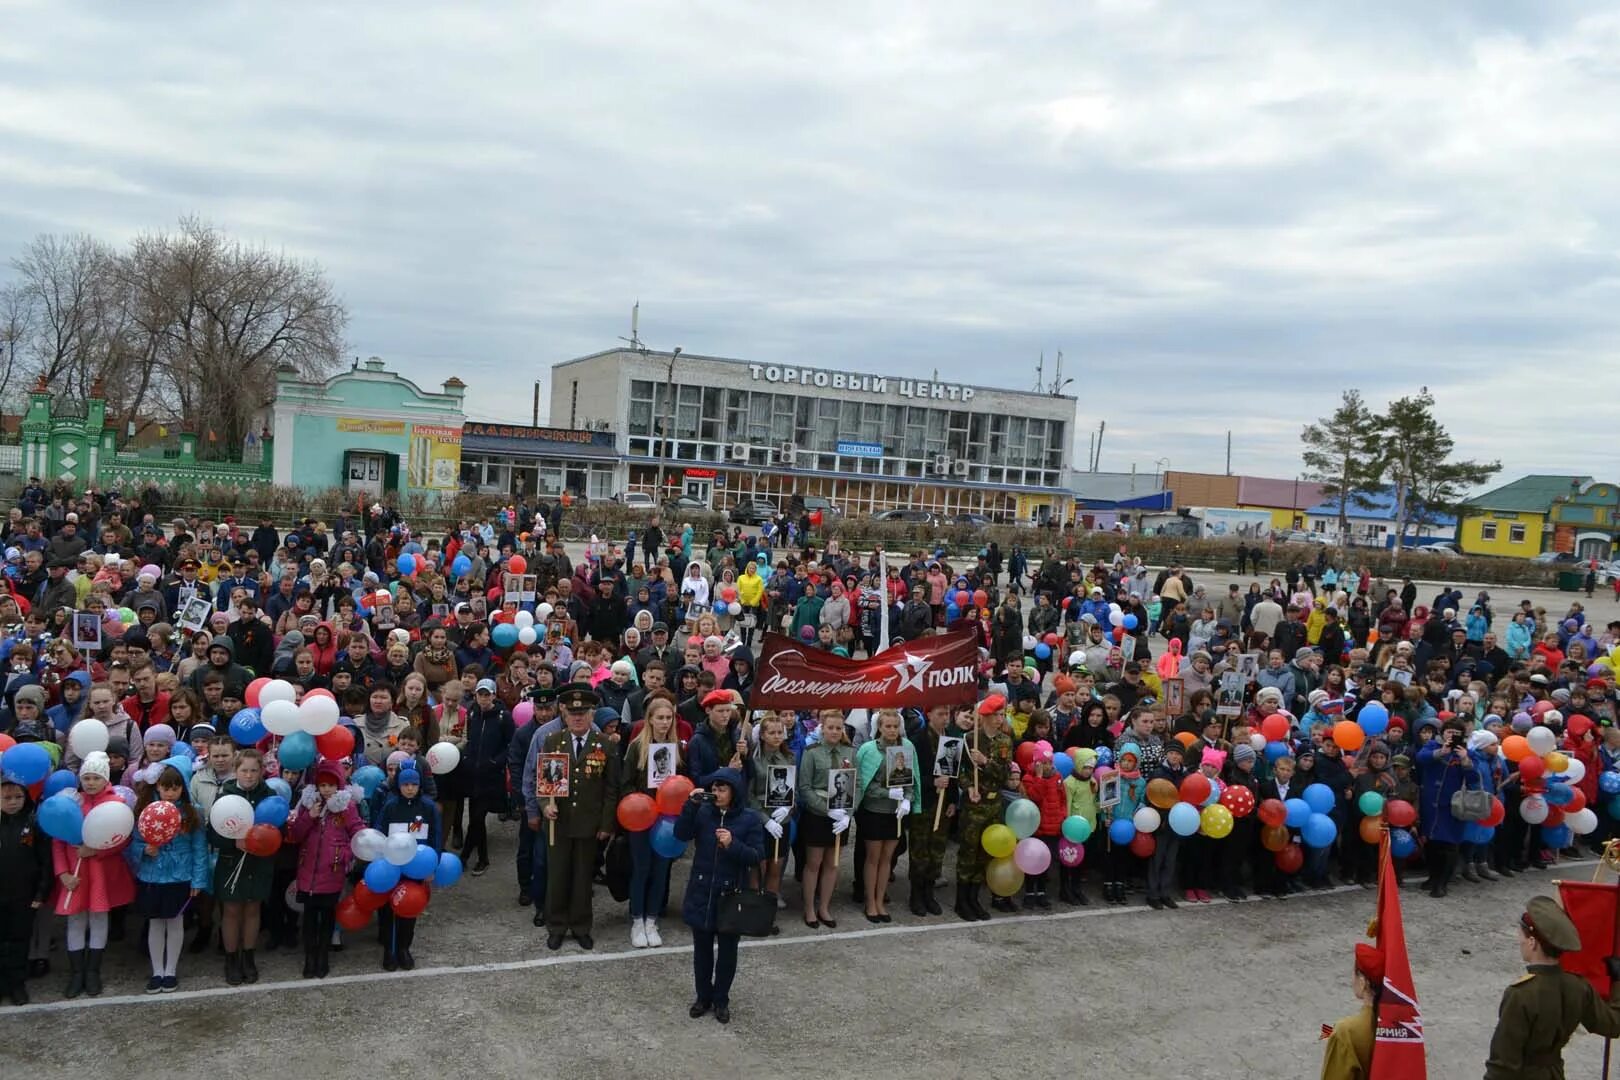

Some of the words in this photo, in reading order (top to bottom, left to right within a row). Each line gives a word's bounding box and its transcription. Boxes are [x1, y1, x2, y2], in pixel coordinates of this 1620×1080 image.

[749, 364, 887, 393] ТОРГОВЫЙ
[899, 380, 975, 401] ЦЕНТР
[928, 664, 975, 688] ПОЛК
